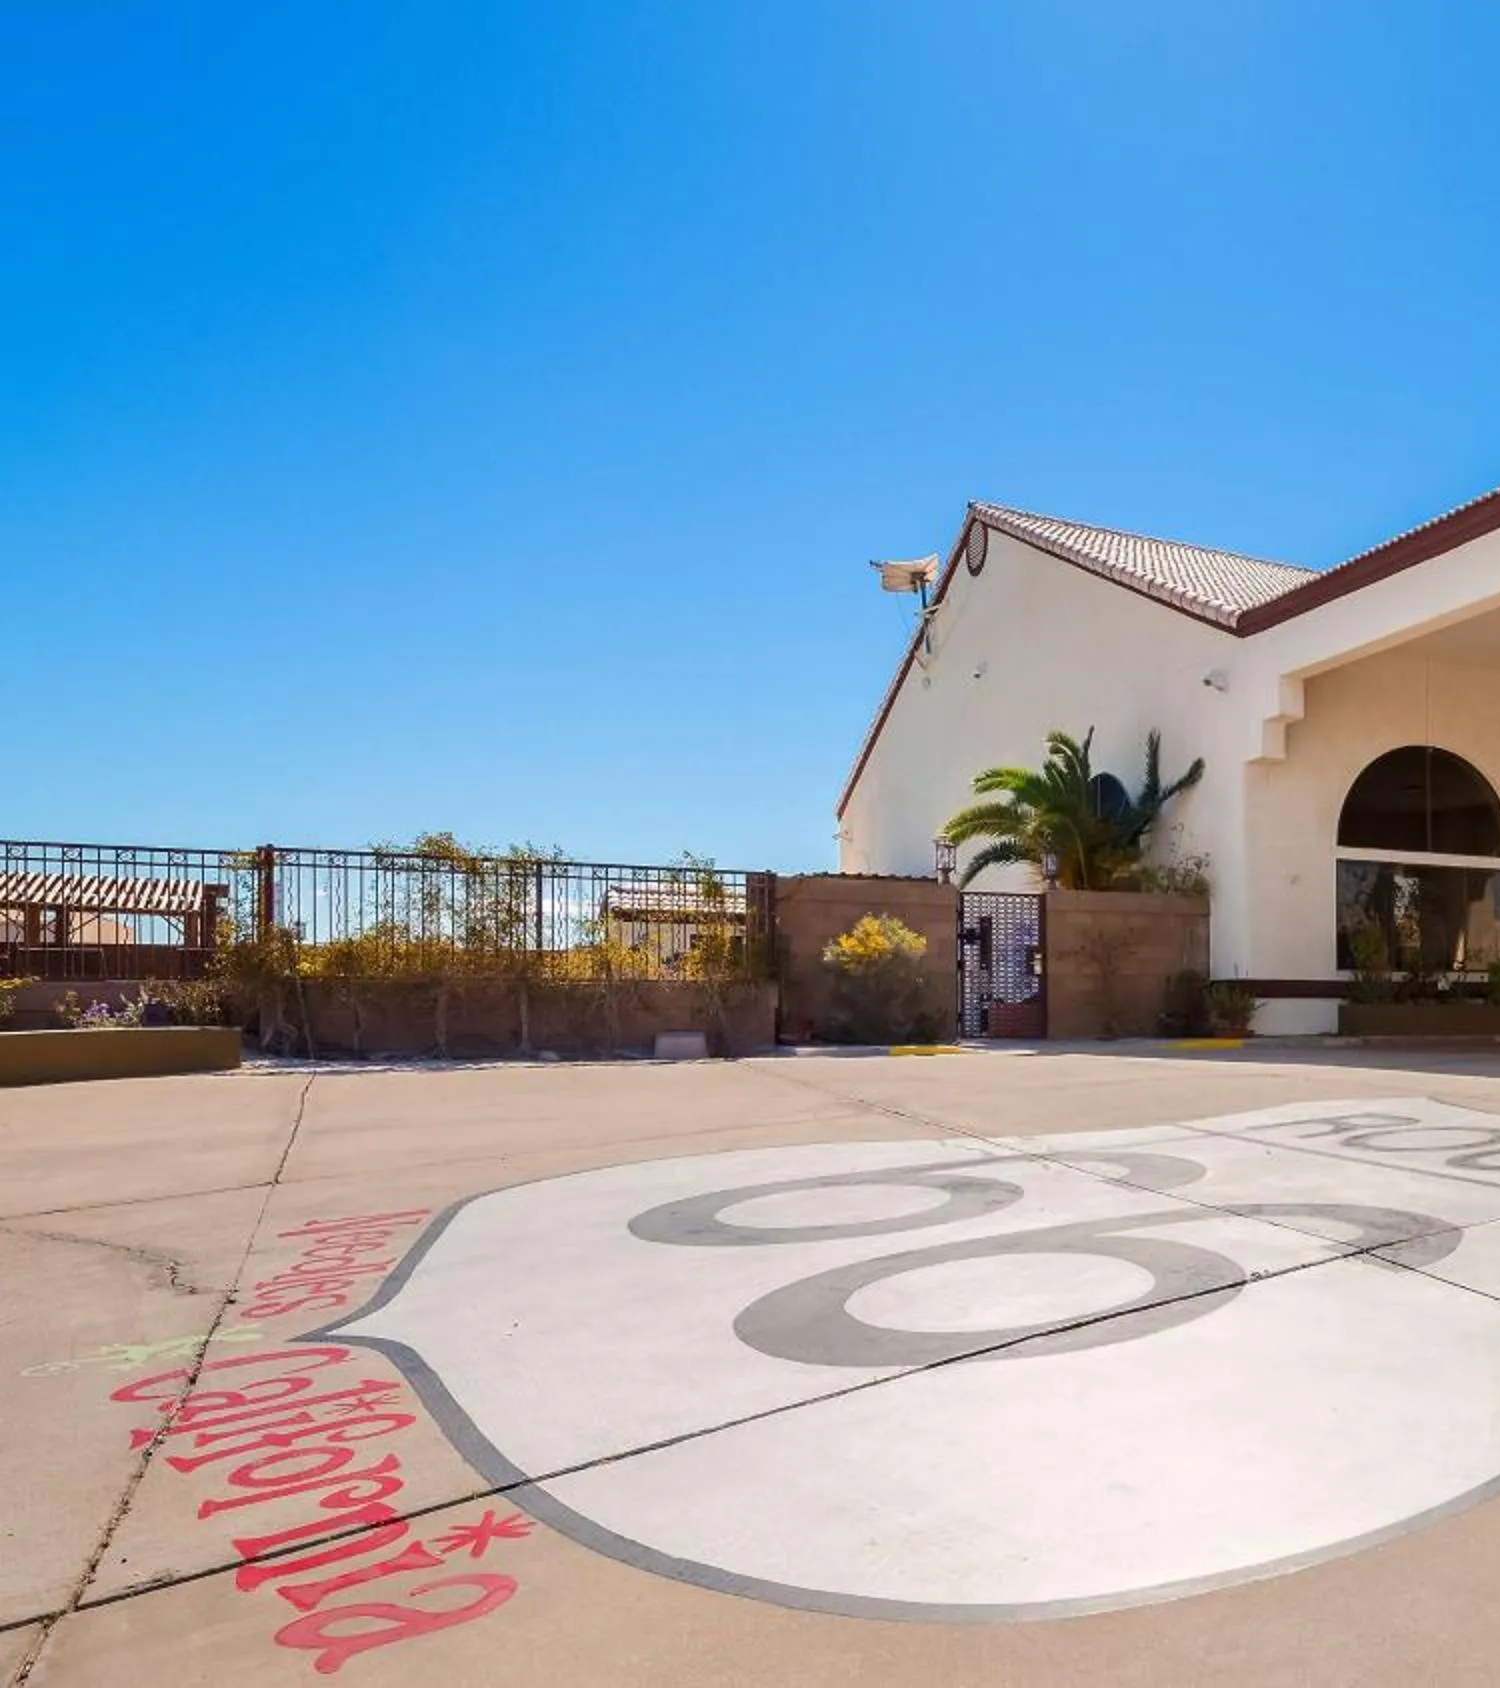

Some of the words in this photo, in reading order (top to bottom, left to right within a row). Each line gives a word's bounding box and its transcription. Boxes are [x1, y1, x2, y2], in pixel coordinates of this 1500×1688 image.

[240, 1209, 431, 1319] Needles
[628, 1151, 1463, 1368] 66
[110, 1347, 535, 1675] California
